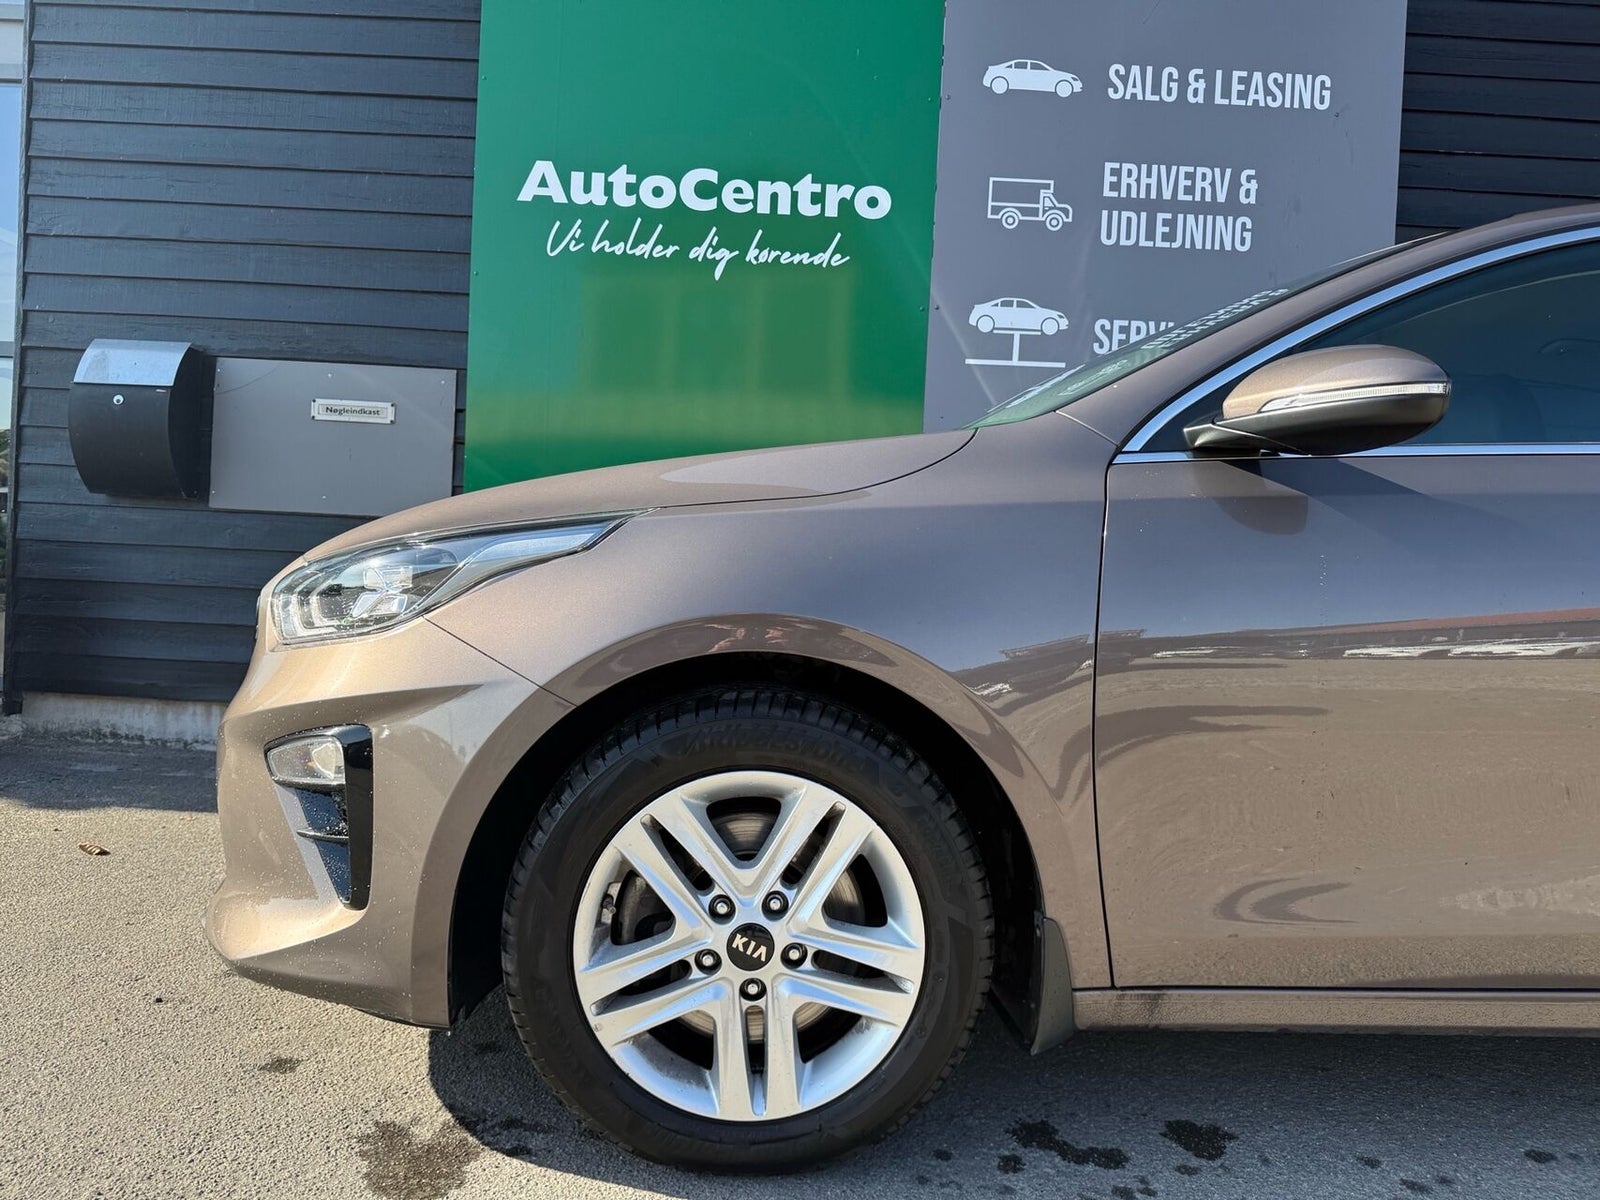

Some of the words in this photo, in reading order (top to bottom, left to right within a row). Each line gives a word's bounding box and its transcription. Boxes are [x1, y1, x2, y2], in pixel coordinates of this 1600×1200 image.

[1108, 64, 1178, 102] SALG
[1187, 69, 1206, 103] &
[1215, 70, 1331, 110] LEASING
[517, 160, 891, 219] AutoCentro
[1103, 162, 1231, 202] ERHVERV
[1240, 169, 1258, 204] &
[547, 219, 584, 256] Vi
[591, 217, 679, 259] holder
[689, 227, 739, 280] dig
[746, 229, 850, 268] kørende
[1101, 210, 1252, 251] UDLEJNING
[1093, 318, 1175, 355] SER
[326, 407, 380, 415] Nøgleindkast
[732, 934, 767, 961] KIA
